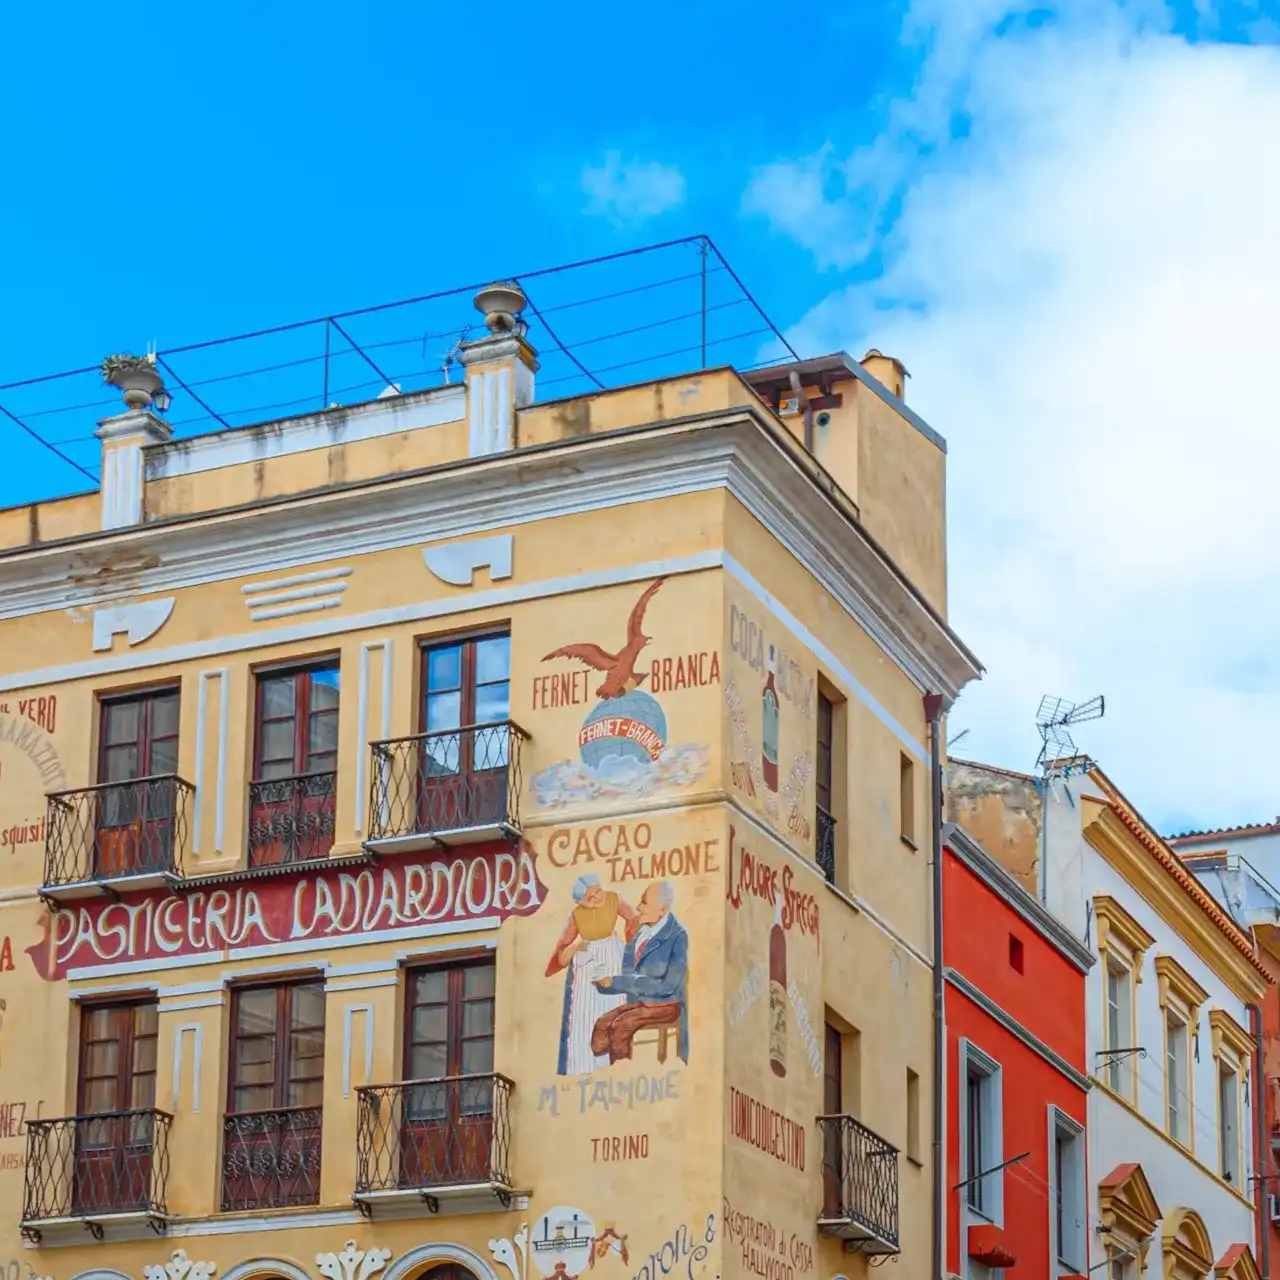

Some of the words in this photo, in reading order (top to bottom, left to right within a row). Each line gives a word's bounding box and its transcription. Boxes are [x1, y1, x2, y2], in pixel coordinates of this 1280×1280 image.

[730, 604, 765, 676] COCA
[533, 670, 590, 710] FERNET
[651, 650, 721, 693] BRANCA
[19, 695, 57, 734] VERO
[1, 816, 46, 854] squisit
[547, 822, 652, 869] CACAO
[606, 838, 720, 883] TALMONE
[290, 853, 542, 939] LAMARMORA
[726, 824, 777, 909] LIQUORE
[781, 864, 820, 957] STREGA
[578, 1069, 680, 1114] TALMONE
[591, 1133, 649, 1163] TORINO
[789, 1233, 813, 1273] CASSA
